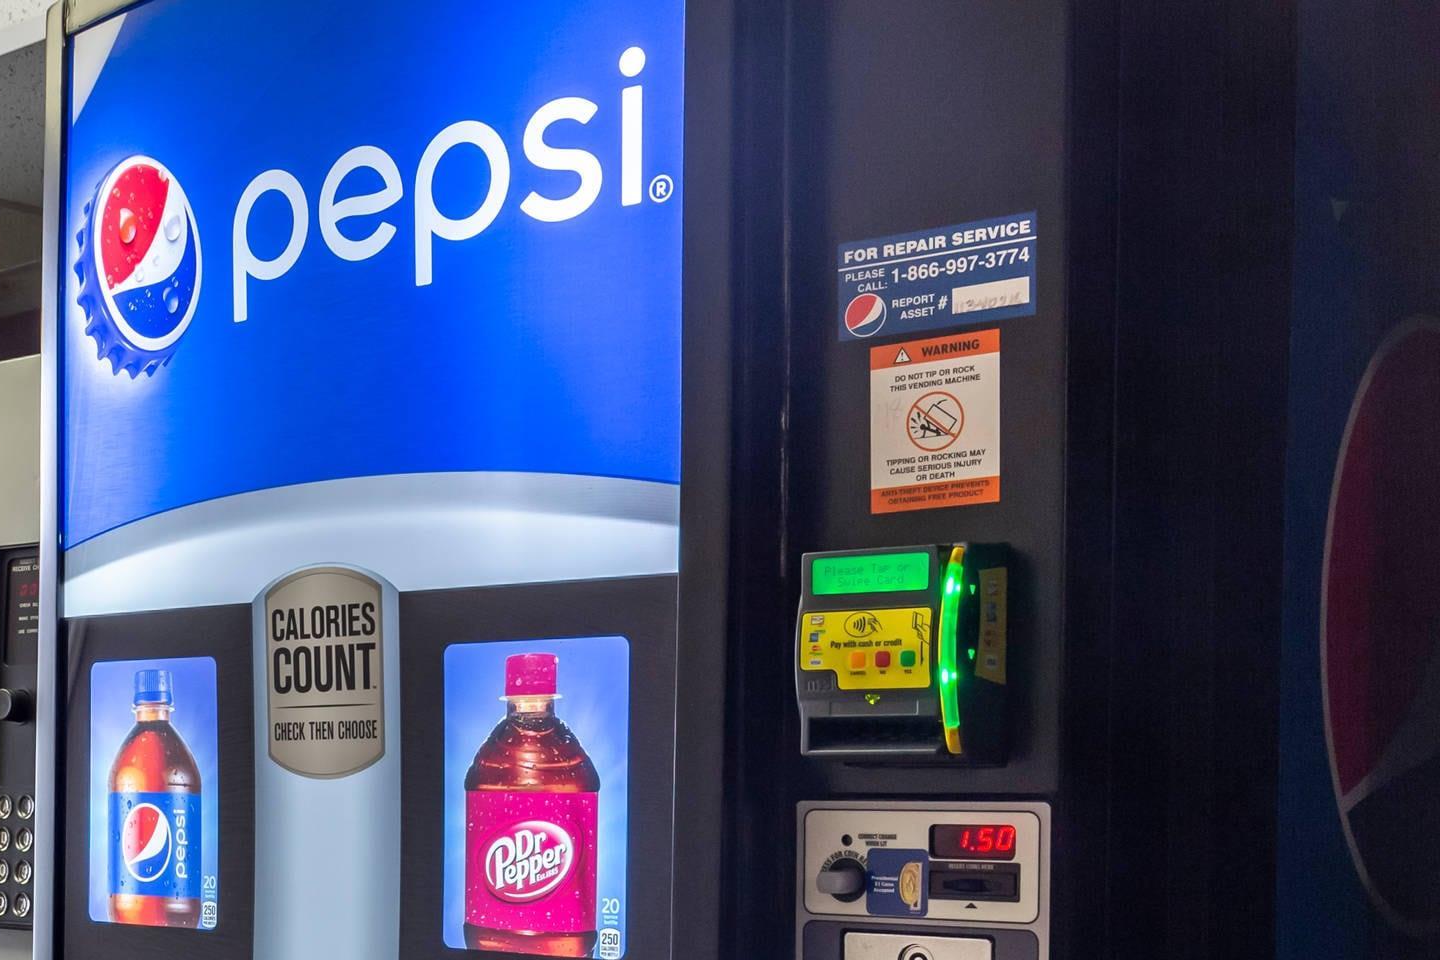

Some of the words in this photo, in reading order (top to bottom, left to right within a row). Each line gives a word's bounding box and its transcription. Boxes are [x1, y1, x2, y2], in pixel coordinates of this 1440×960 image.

[233, 46, 646, 323] pepsi
[844, 248, 878, 264] FOR
[883, 235, 947, 258] REPAIR
[952, 220, 1031, 246] SERVICE
[891, 246, 1030, 283] 1-866-997-3774
[845, 268, 885, 282] PLEASE
[857, 280, 889, 293] CALL:
[892, 294, 935, 308] REPORT
[900, 306, 935, 320] ASSET
[921, 339, 980, 357] WARNING
[894, 374, 906, 383] DO
[908, 372, 924, 382] NOT
[925, 370, 937, 379] TIP
[939, 368, 951, 377] OR
[953, 364, 975, 375] ROCK
[889, 383, 907, 393] THIS
[908, 378, 943, 390] VENDING
[944, 373, 980, 385] MACHINE
[886, 456, 916, 467] TIPPING
[917, 455, 930, 464] OR
[931, 451, 967, 462] ROCKING
[969, 449, 986, 457] MAY
[889, 466, 916, 475] CAUSE
[917, 462, 951, 473] SERIOUS
[953, 458, 982, 469] INJURY
[915, 473, 928, 482] OR
[929, 471, 955, 480] DEATH
[272, 602, 376, 642] CALORIES
[830, 640, 842, 650] Pay
[843, 639, 857, 648] with
[858, 639, 873, 647] cash
[883, 638, 902, 646] credit
[273, 643, 376, 694] COUNT
[274, 722, 305, 741] CHECK
[309, 721, 334, 740] THEN
[338, 719, 377, 739] CHOOSE
[172, 808, 188, 878] pepsi
[515, 829, 547, 862] Dr
[960, 826, 1015, 852] 1.50
[486, 836, 567, 890] Pepper
[203, 875, 216, 889] 20
[203, 905, 216, 916] 250
[601, 898, 620, 914] 20
[601, 933, 619, 945] 250
